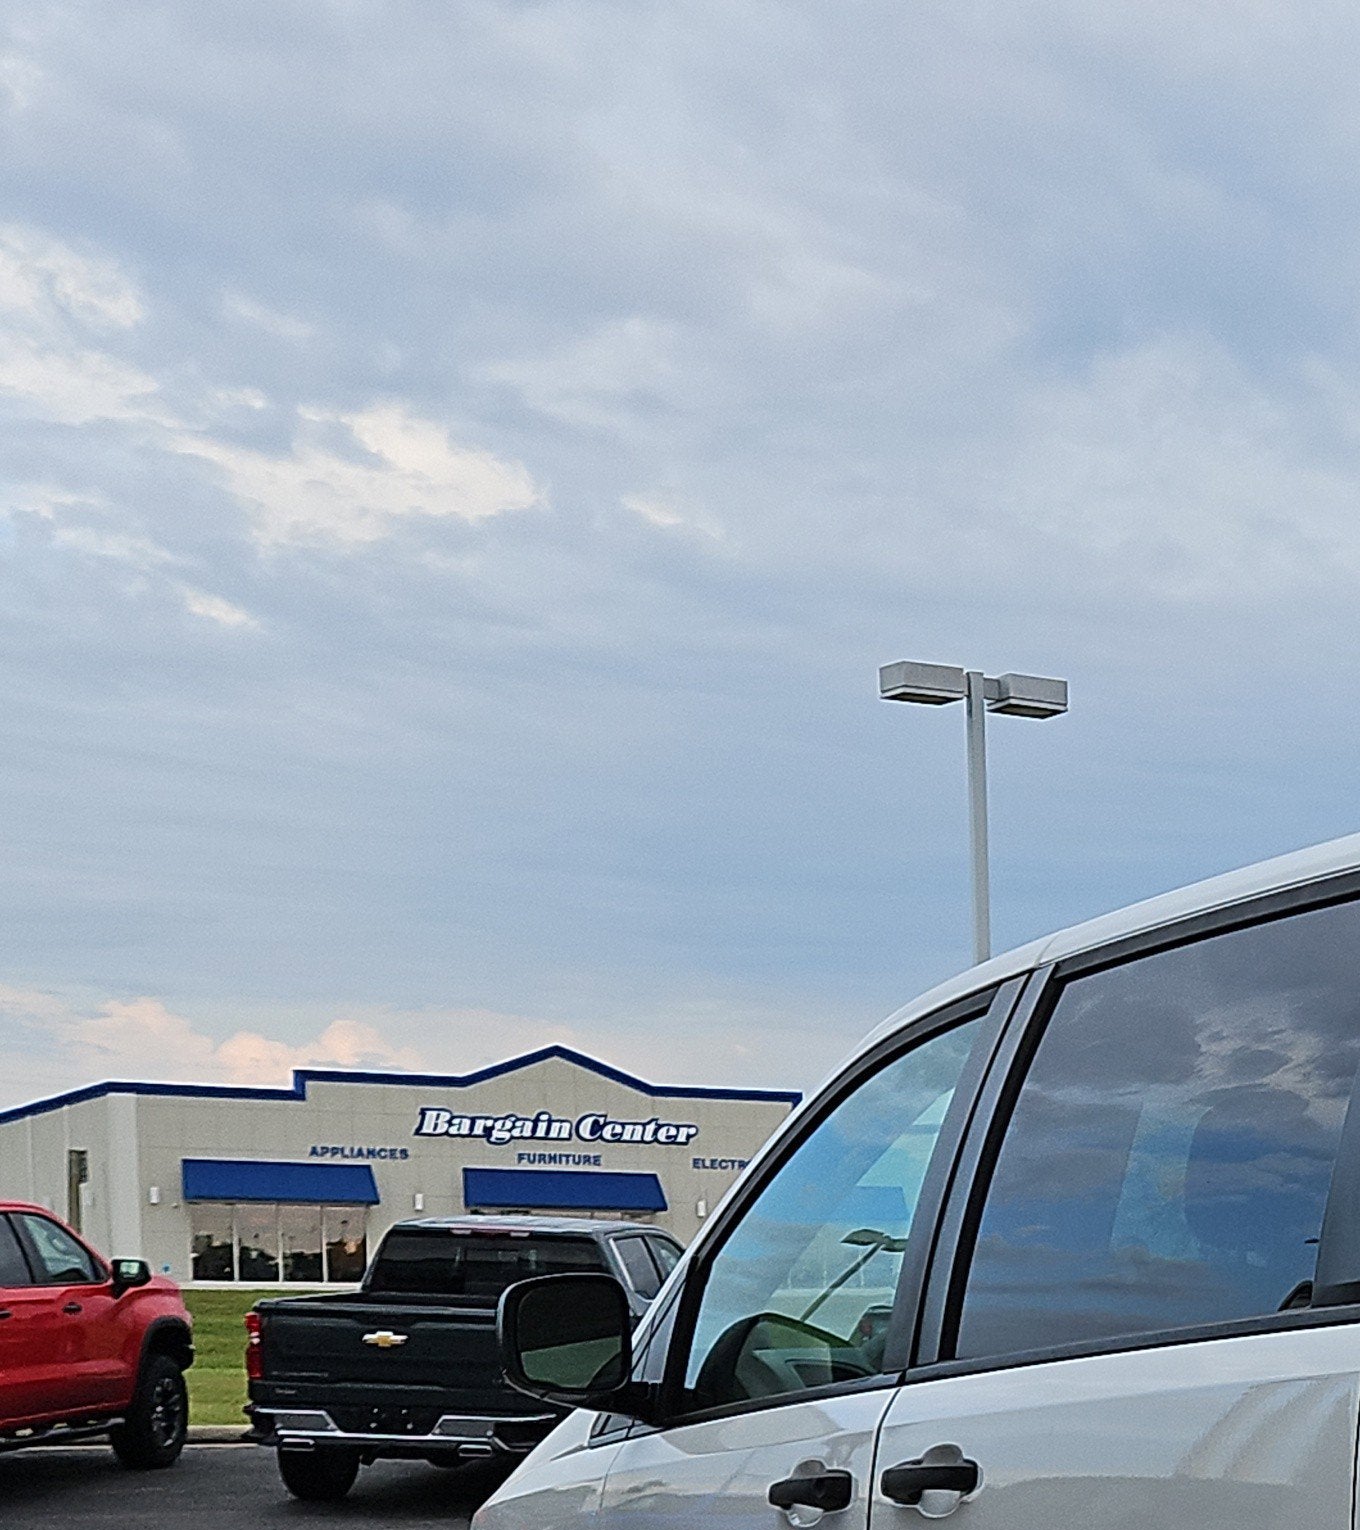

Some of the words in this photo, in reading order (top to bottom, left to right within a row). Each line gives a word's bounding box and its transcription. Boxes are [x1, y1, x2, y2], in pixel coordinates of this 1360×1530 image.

[415, 1108, 572, 1144] Bargain
[575, 1112, 698, 1144] Center
[309, 1146, 409, 1160] APPLIANCES
[517, 1153, 602, 1166] FURNITURE
[692, 1157, 751, 1170] ELECTR
